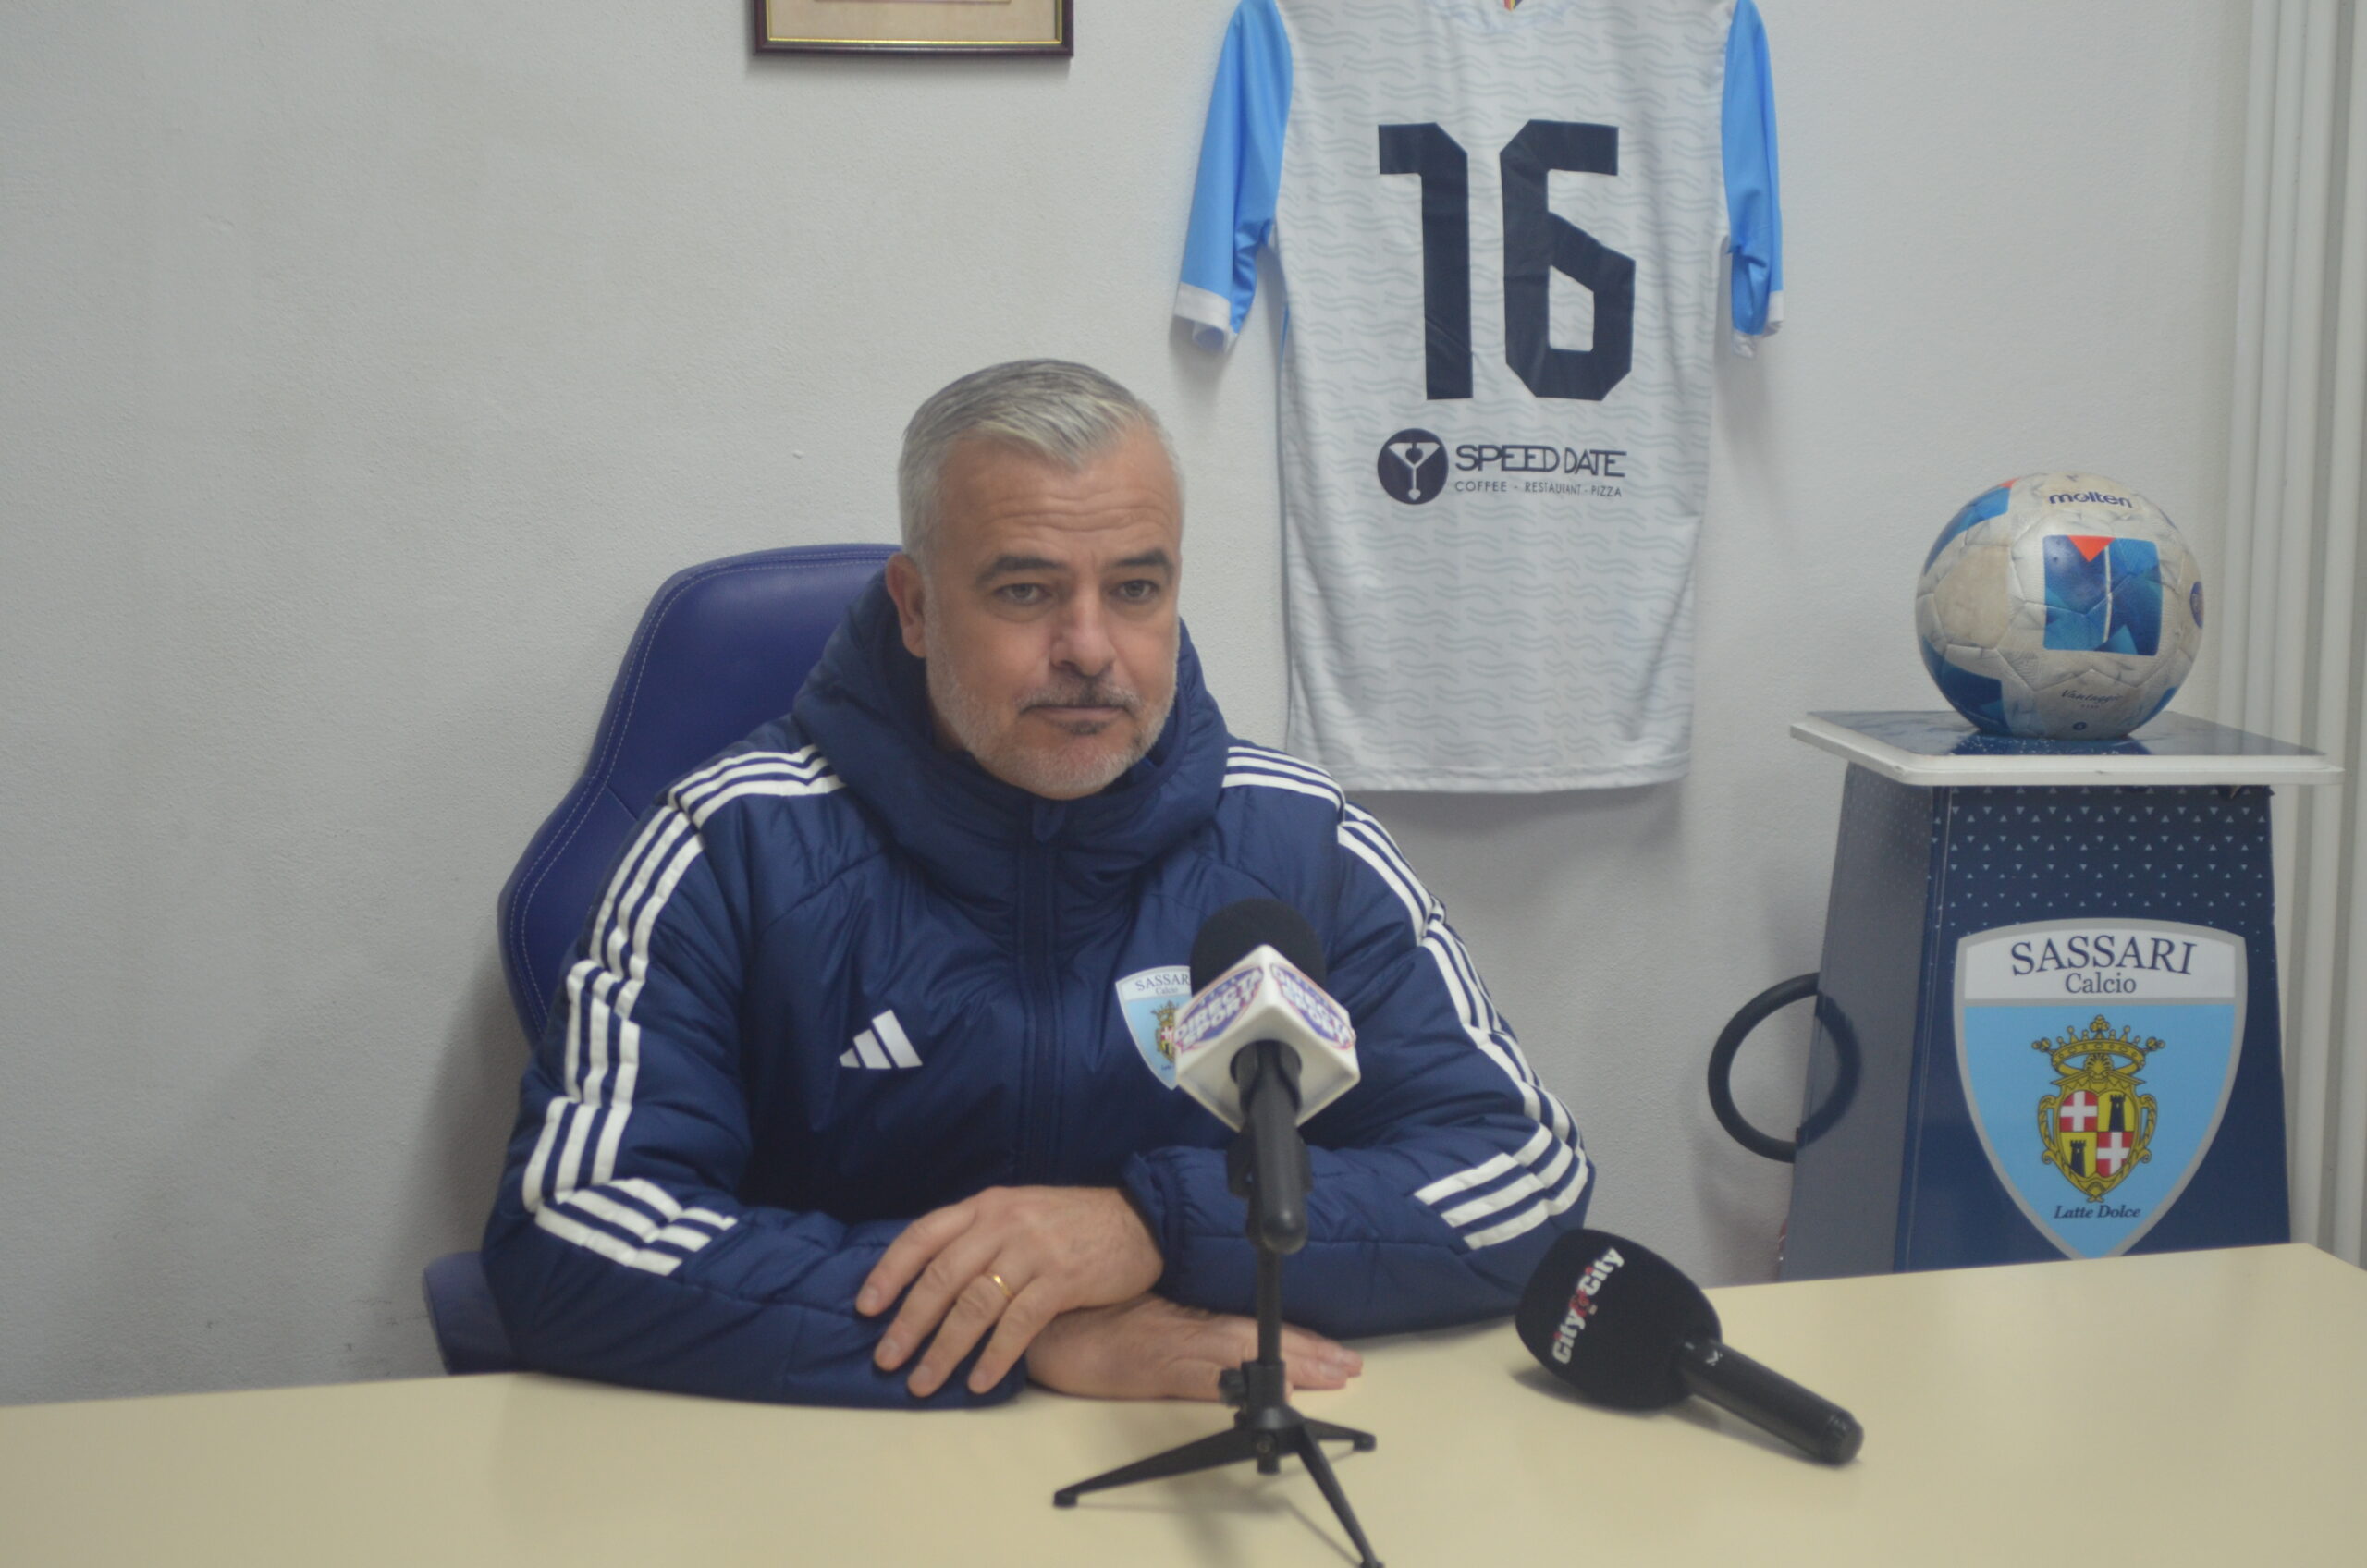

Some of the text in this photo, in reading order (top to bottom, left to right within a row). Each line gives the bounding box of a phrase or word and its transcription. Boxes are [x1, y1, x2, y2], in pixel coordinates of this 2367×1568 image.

[1379, 118, 1636, 401] 16
[1455, 445, 1627, 477] SPEED DATE
[1455, 480, 1507, 492] COFFEE
[1591, 485, 1622, 497] PIZZA
[2049, 491, 2134, 508] molten
[2010, 935, 2198, 976] SASSARI
[1134, 973, 1190, 992] SASSAR
[2066, 973, 2137, 994] Calcio
[2054, 1205, 2140, 1219] Latte Dolce
